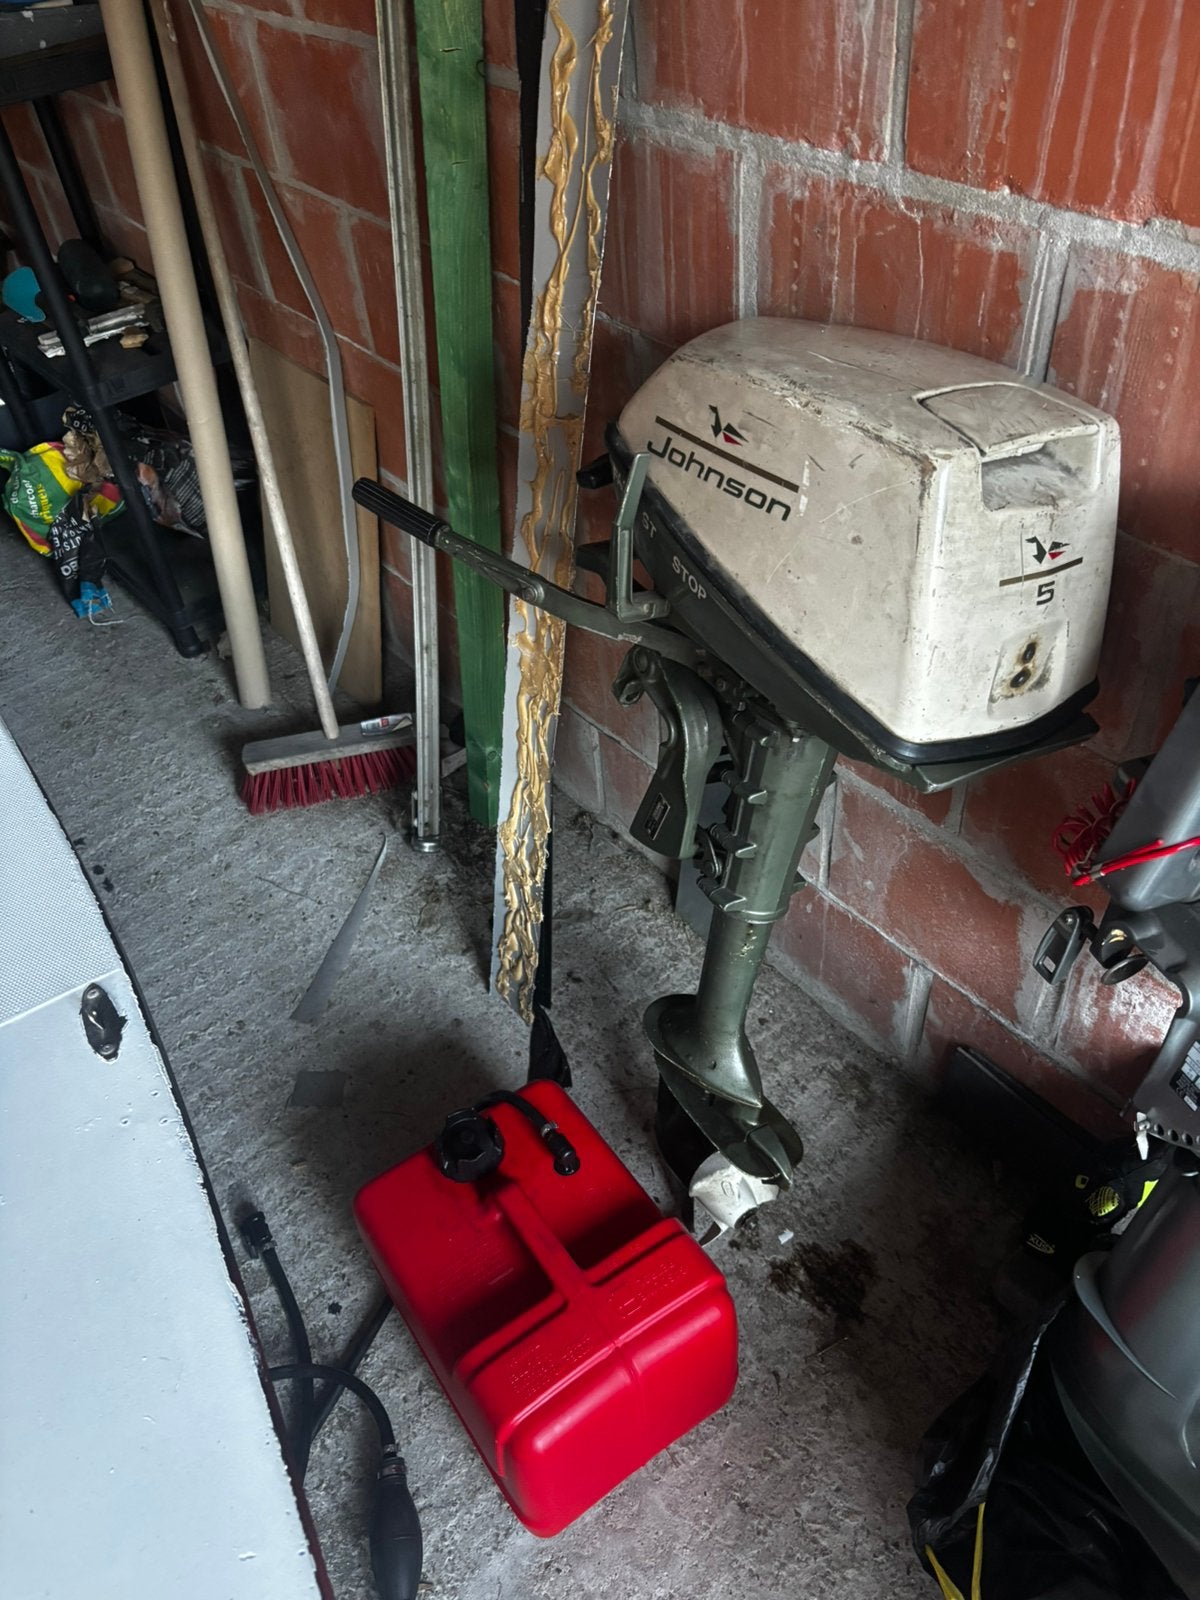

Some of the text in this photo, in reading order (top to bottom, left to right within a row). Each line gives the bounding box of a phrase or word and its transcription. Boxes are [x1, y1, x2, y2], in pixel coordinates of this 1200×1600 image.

[647, 437, 792, 521] Johnson
[672, 556, 707, 600] STOP
[1036, 580, 1055, 606] 5
